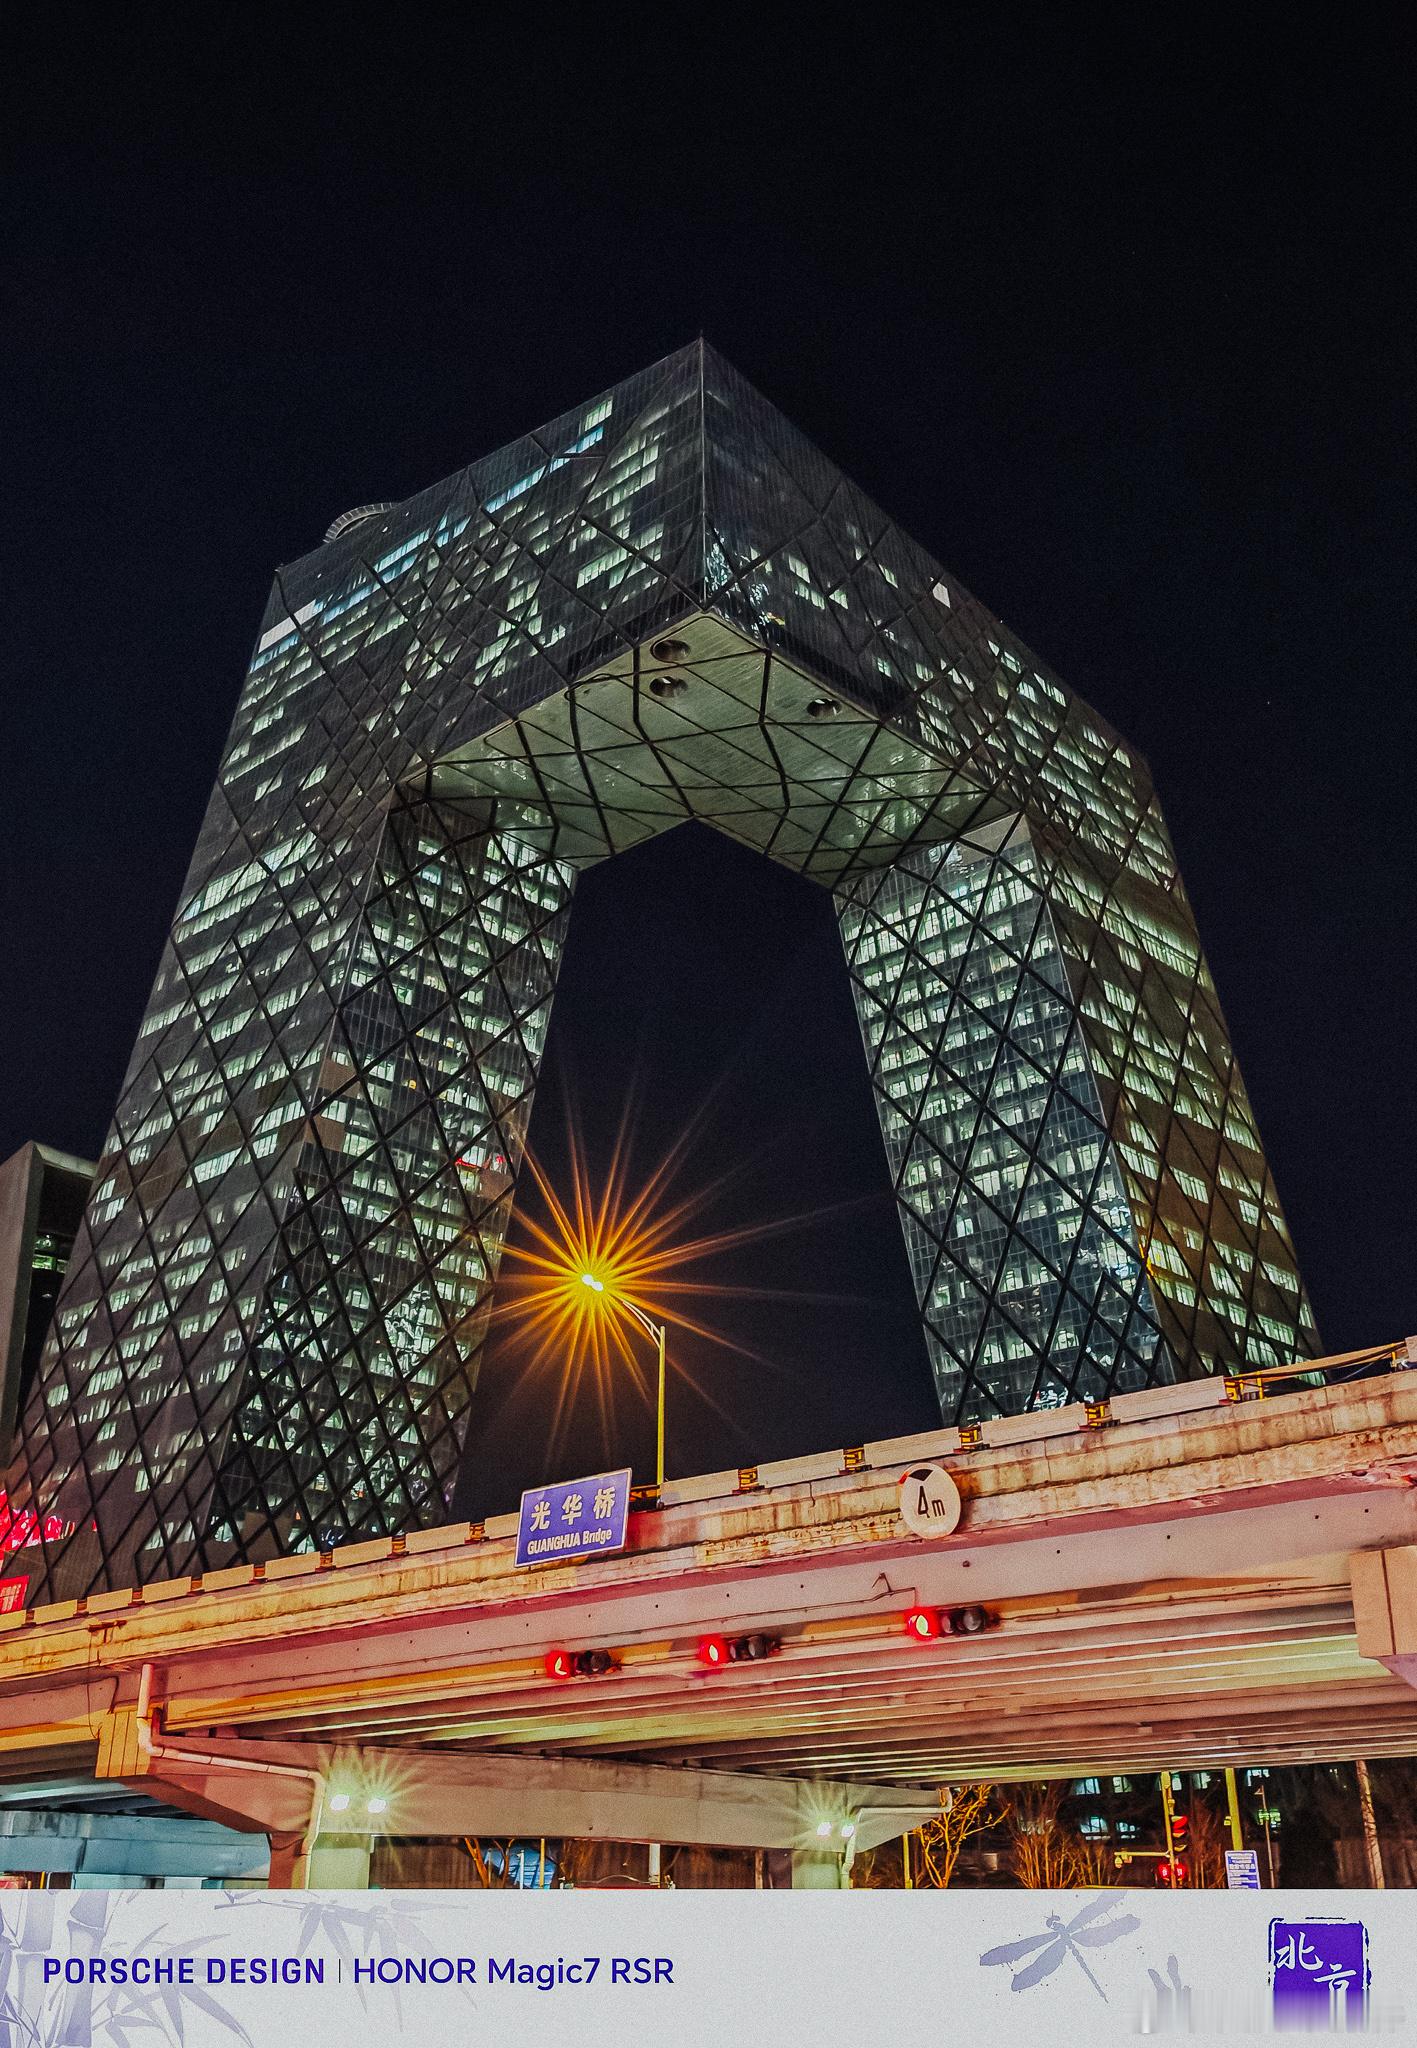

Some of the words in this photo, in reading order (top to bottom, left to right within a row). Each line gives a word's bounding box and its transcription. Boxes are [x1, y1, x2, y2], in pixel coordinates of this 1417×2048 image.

[529, 1486, 616, 1532] 光华桥
[527, 1532, 581, 1555] GUANGHUA
[582, 1527, 613, 1545] Bridge
